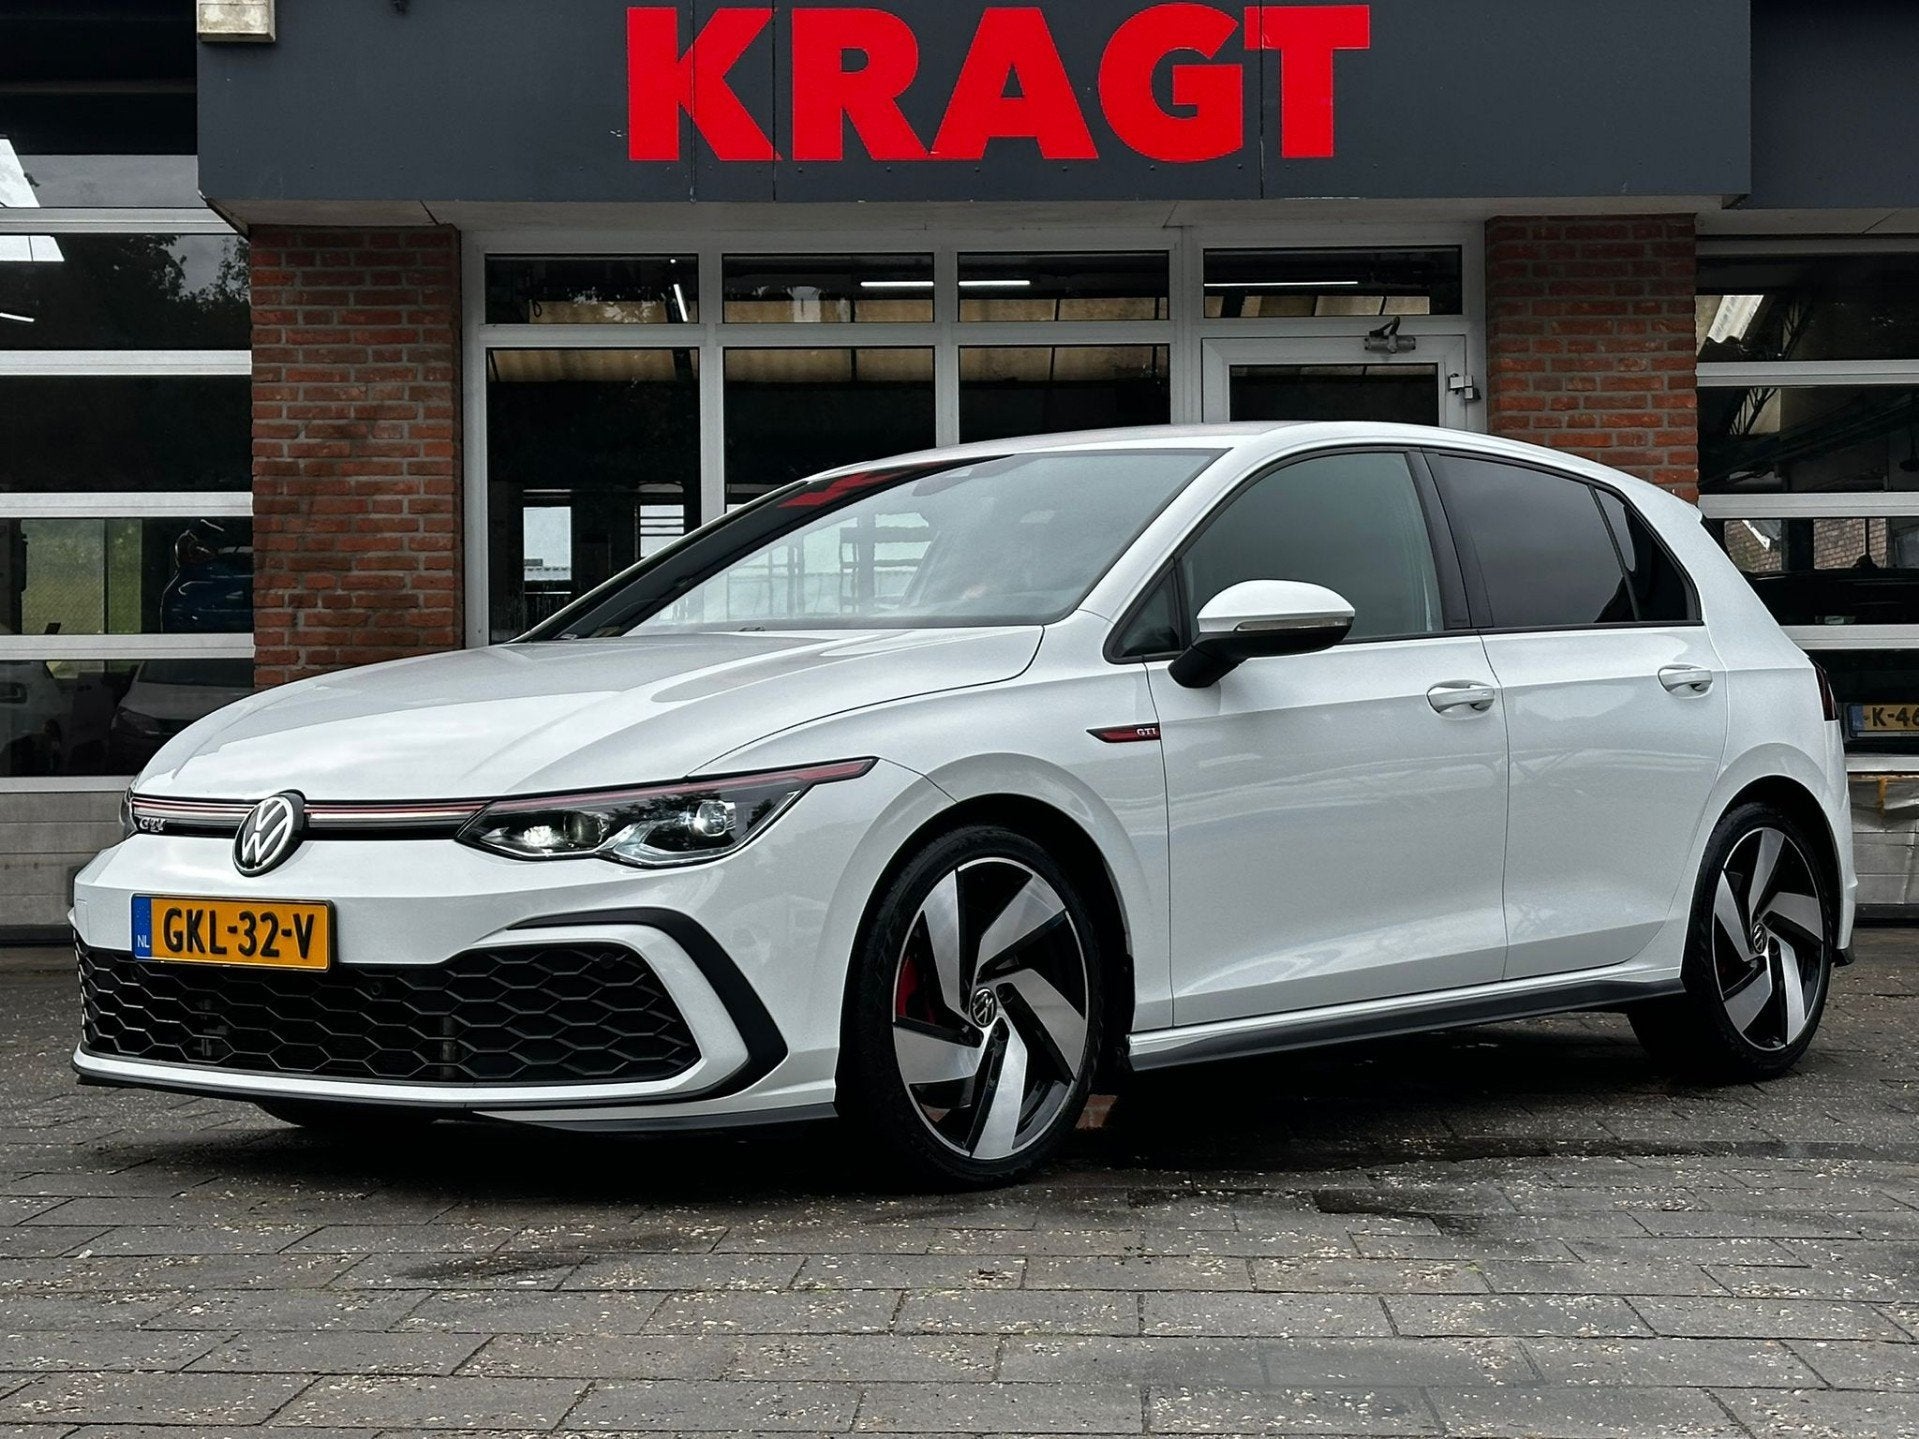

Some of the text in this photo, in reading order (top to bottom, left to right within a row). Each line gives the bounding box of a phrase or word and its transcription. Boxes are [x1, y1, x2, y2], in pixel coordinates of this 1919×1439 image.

[627, 3, 1371, 162] KRAGT
[1136, 727, 1157, 737] GTI
[137, 934, 150, 948] NL
[162, 906, 316, 960] GKL-32-V
